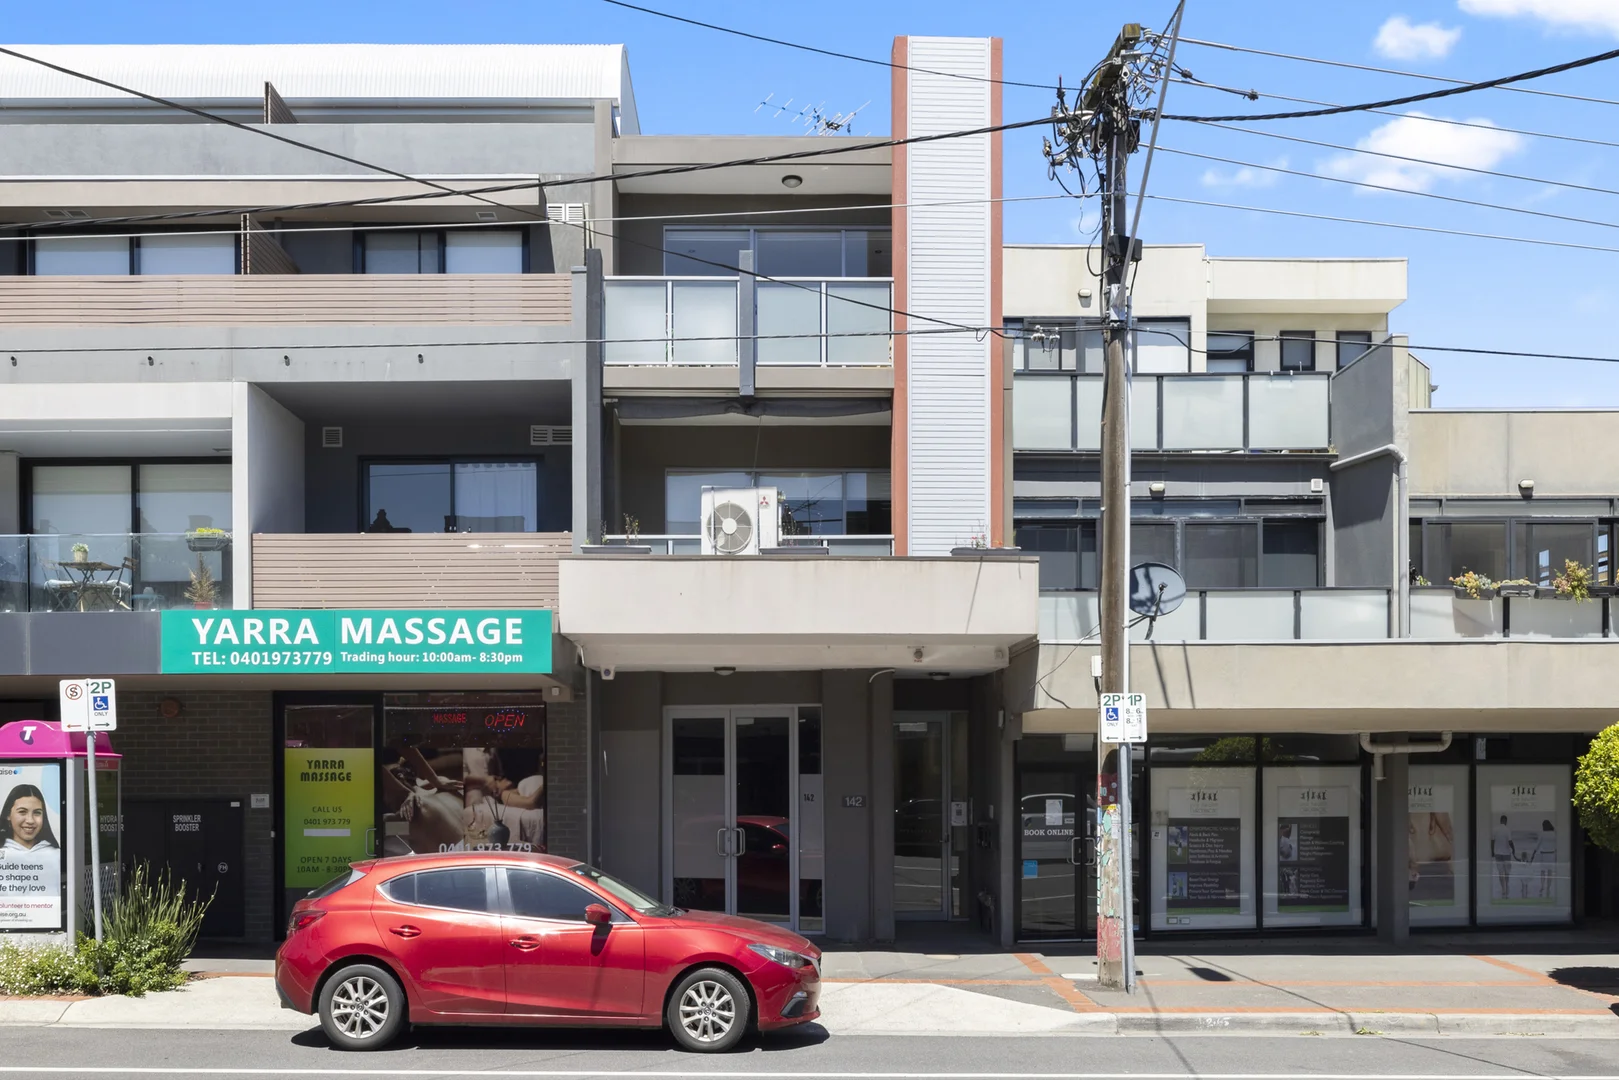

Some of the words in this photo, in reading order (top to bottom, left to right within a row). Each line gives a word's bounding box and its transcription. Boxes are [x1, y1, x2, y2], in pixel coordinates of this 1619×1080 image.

[191, 618, 320, 645] YARRA
[341, 617, 523, 645] MASSAGE
[191, 651, 226, 665] TEL:
[230, 651, 333, 665] 0401973779
[340, 652, 385, 664] Trading
[388, 652, 420, 663] hour:
[422, 652, 476, 663] 10:00am-
[479, 652, 523, 665] 8:30pm
[90, 681, 112, 694] 2P
[1103, 694, 1121, 706] 2P
[1127, 694, 1142, 706] 1P
[433, 713, 467, 724] MASSAGE
[484, 714, 526, 727] OPEN
[22, 725, 37, 741] T
[306, 760, 345, 770] YARRA
[300, 772, 352, 782] MASSAGE
[845, 796, 863, 807] 142
[100, 814, 125, 823] HYDRAT
[172, 814, 202, 823] SPRINKLER
[303, 818, 321, 826] 0401
[323, 818, 336, 826] 973
[337, 818, 351, 826] 779
[100, 823, 125, 832] BOOSTR
[174, 823, 200, 832] BOOSTER
[300, 856, 323, 864] OPEN
[324, 856, 330, 864] 7
[330, 856, 352, 864] DAYS
[21, 863, 44, 871] teens
[5, 874, 32, 883] shape
[8, 884, 28, 893] they
[28, 884, 46, 892] love
